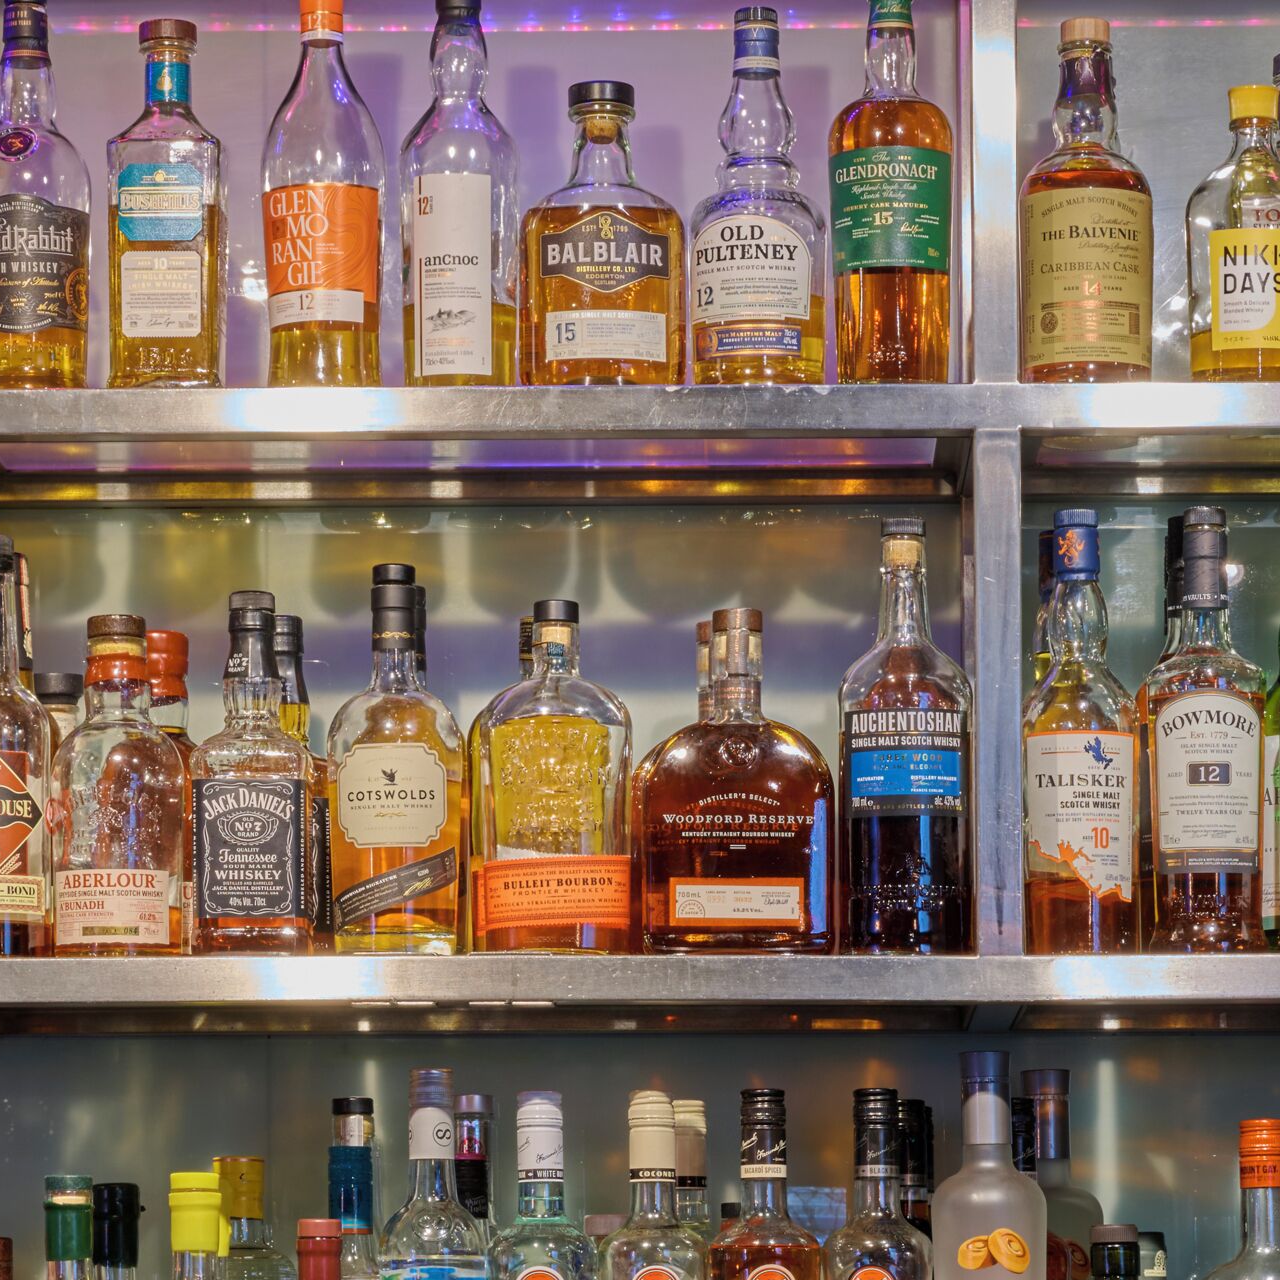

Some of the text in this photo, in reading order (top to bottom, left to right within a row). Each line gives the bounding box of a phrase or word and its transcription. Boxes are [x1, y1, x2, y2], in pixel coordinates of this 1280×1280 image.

[836, 162, 936, 184] GLENDRONACH
[120, 194, 200, 210] BUSHMILLS
[270, 190, 324, 218] GLEN
[15, 228, 74, 256] Rabbit
[720, 225, 764, 242] OLD
[1041, 224, 1139, 242] THE BALVENIE
[424, 254, 480, 267] anCnoc
[548, 242, 664, 268] BALBLAIR
[696, 245, 798, 266] PULTENEY
[12, 262, 58, 274] WHISKEY
[288, 261, 324, 286] GIE
[852, 712, 962, 734] AUCHENTOSHAN
[1162, 710, 1258, 739] BOWMORE
[851, 736, 961, 748] SINGLE MALT SCOTCH WHISKY
[1036, 774, 1126, 790] TALISKER
[204, 788, 295, 820] JACK DANIEL'S
[347, 790, 436, 803] COTSWOLDS
[663, 813, 814, 826] WOODFORD RESERVE
[1091, 827, 1110, 850] 10
[218, 849, 278, 864] Tennessee
[63, 872, 156, 890] ABERLOUR
[215, 870, 282, 881] WHISKEY
